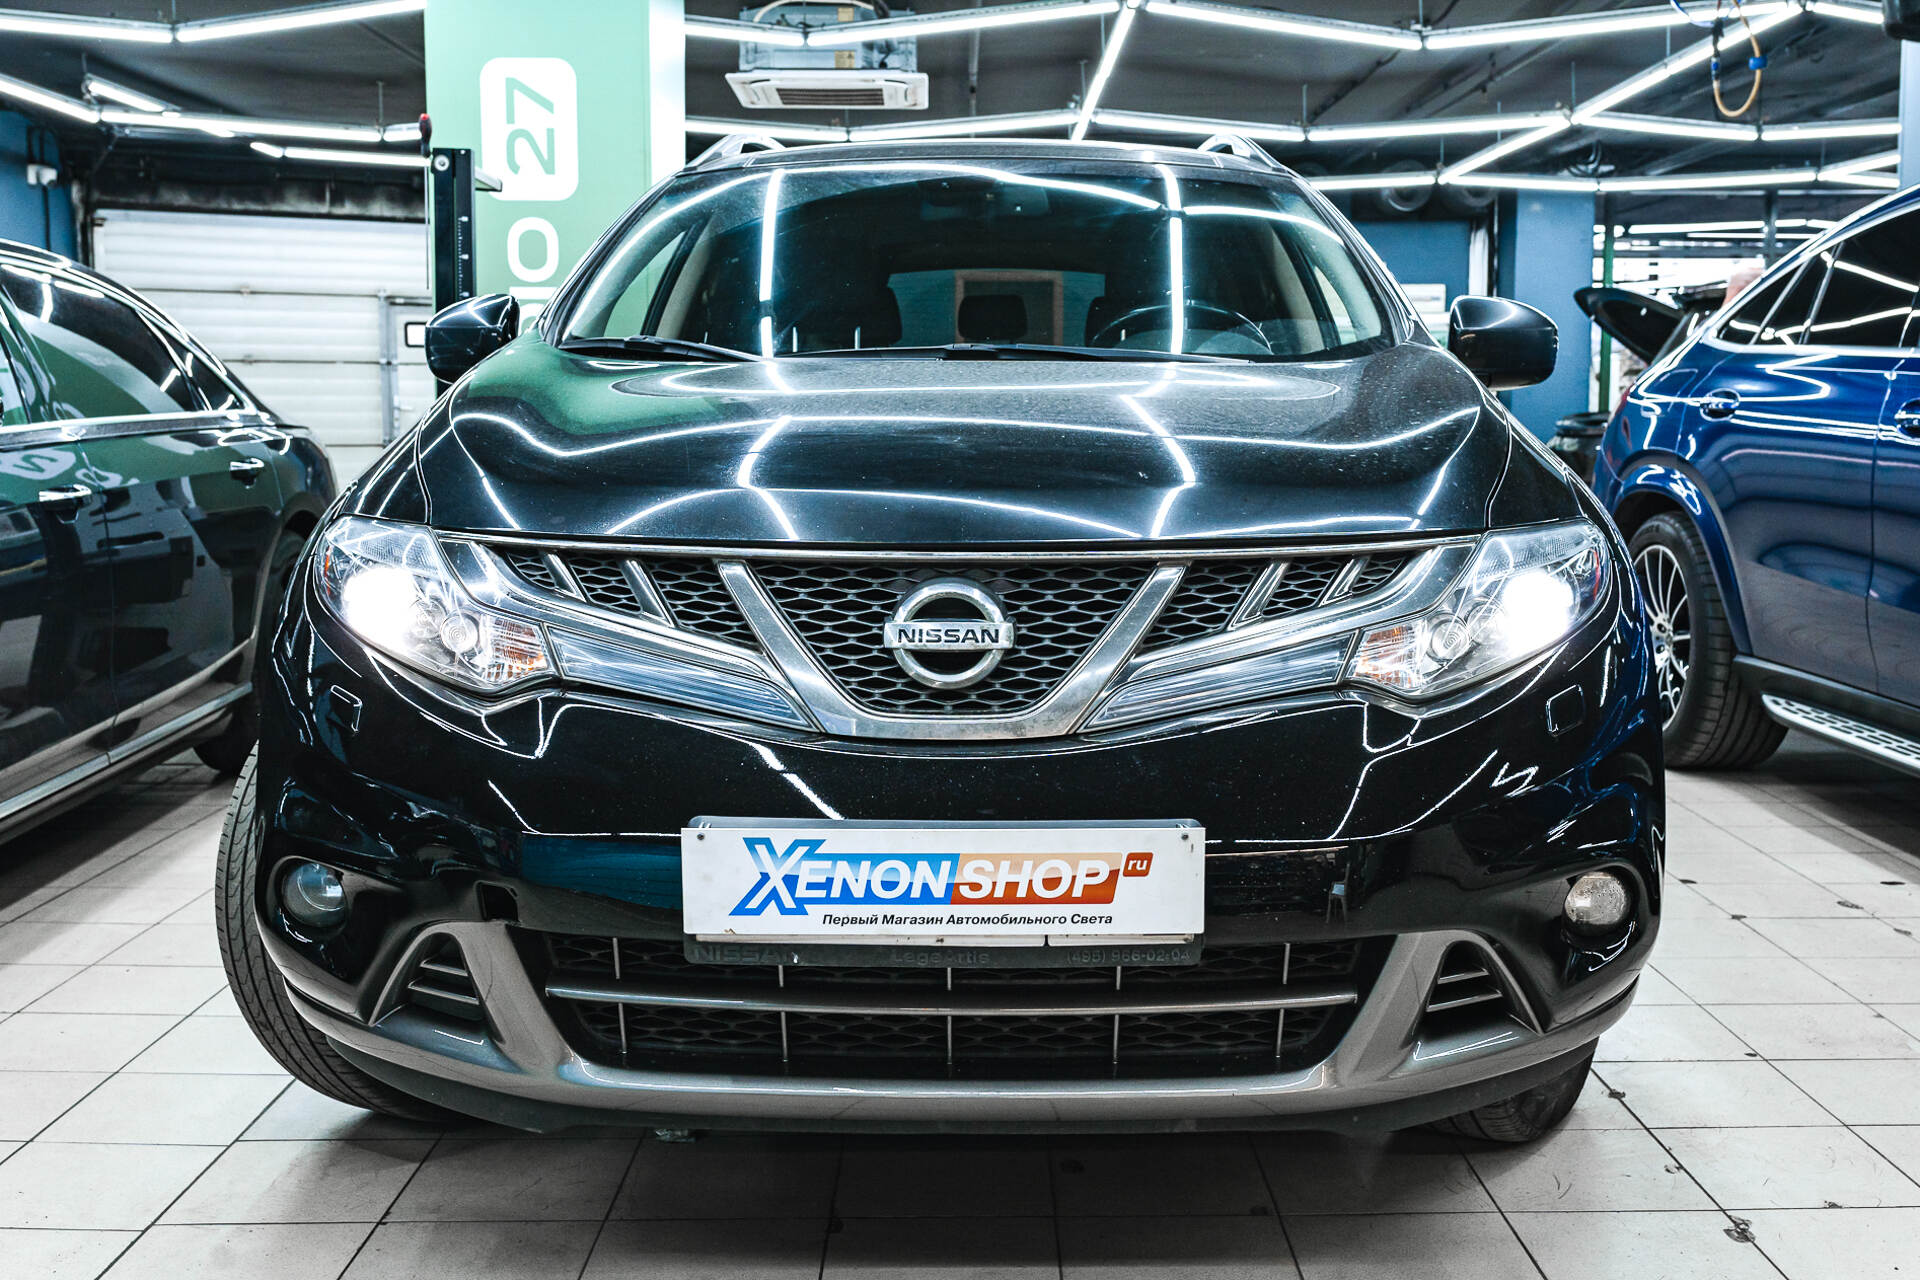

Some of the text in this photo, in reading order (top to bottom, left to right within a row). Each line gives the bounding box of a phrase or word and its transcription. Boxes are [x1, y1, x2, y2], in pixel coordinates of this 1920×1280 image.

[505, 76, 556, 176] 27
[898, 629, 999, 643] NISSAN
[1127, 859, 1148, 871] ru
[822, 913, 1113, 926] Первый Магазин Автомобильного Света
